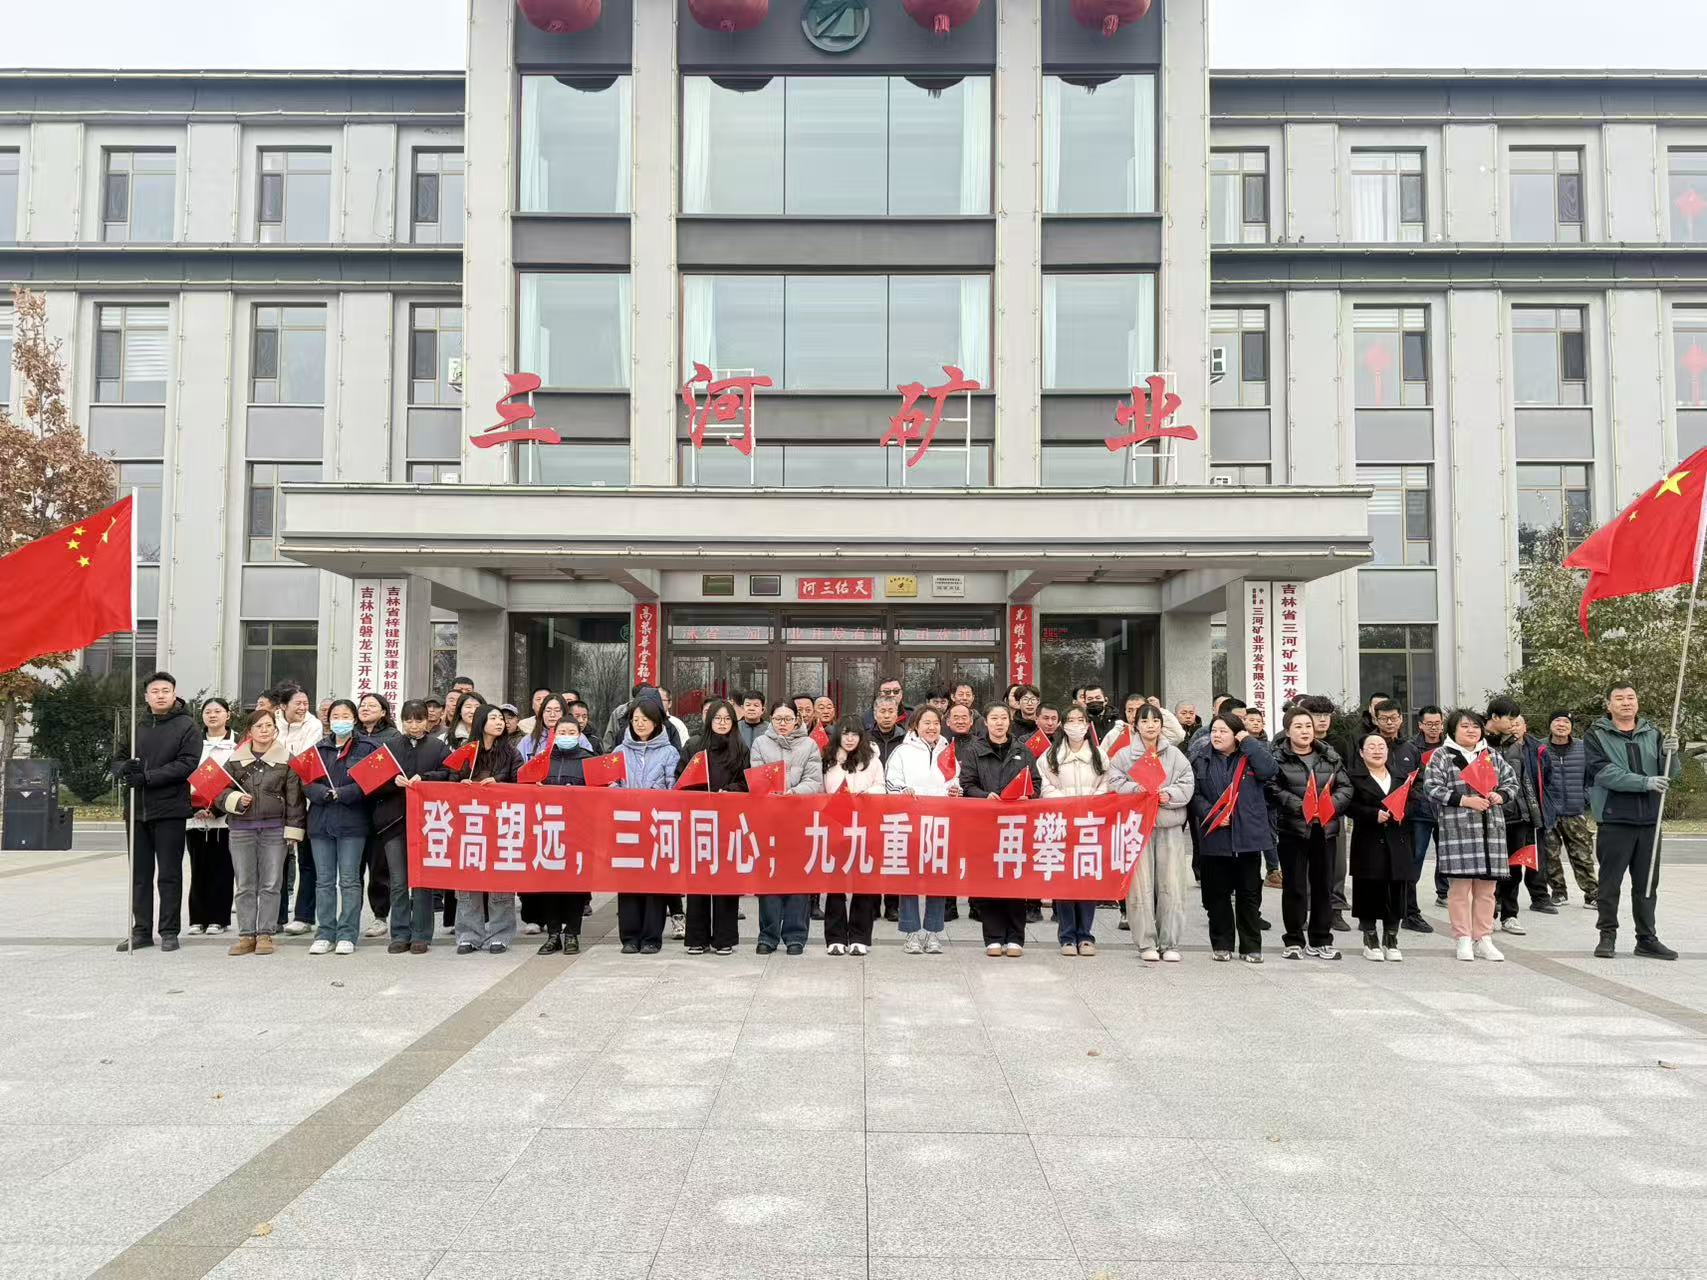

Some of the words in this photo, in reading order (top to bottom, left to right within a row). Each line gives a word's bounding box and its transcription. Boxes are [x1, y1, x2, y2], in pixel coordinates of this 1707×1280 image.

[469, 361, 1199, 467] 三河矿业
[1252, 607, 1266, 726] 三河矿业开发有限公司支
[1281, 583, 1299, 703] 吉林省三河矿业开发
[420, 800, 1144, 882] 登高望远，三河同心；九九重阳，再攀高峰
